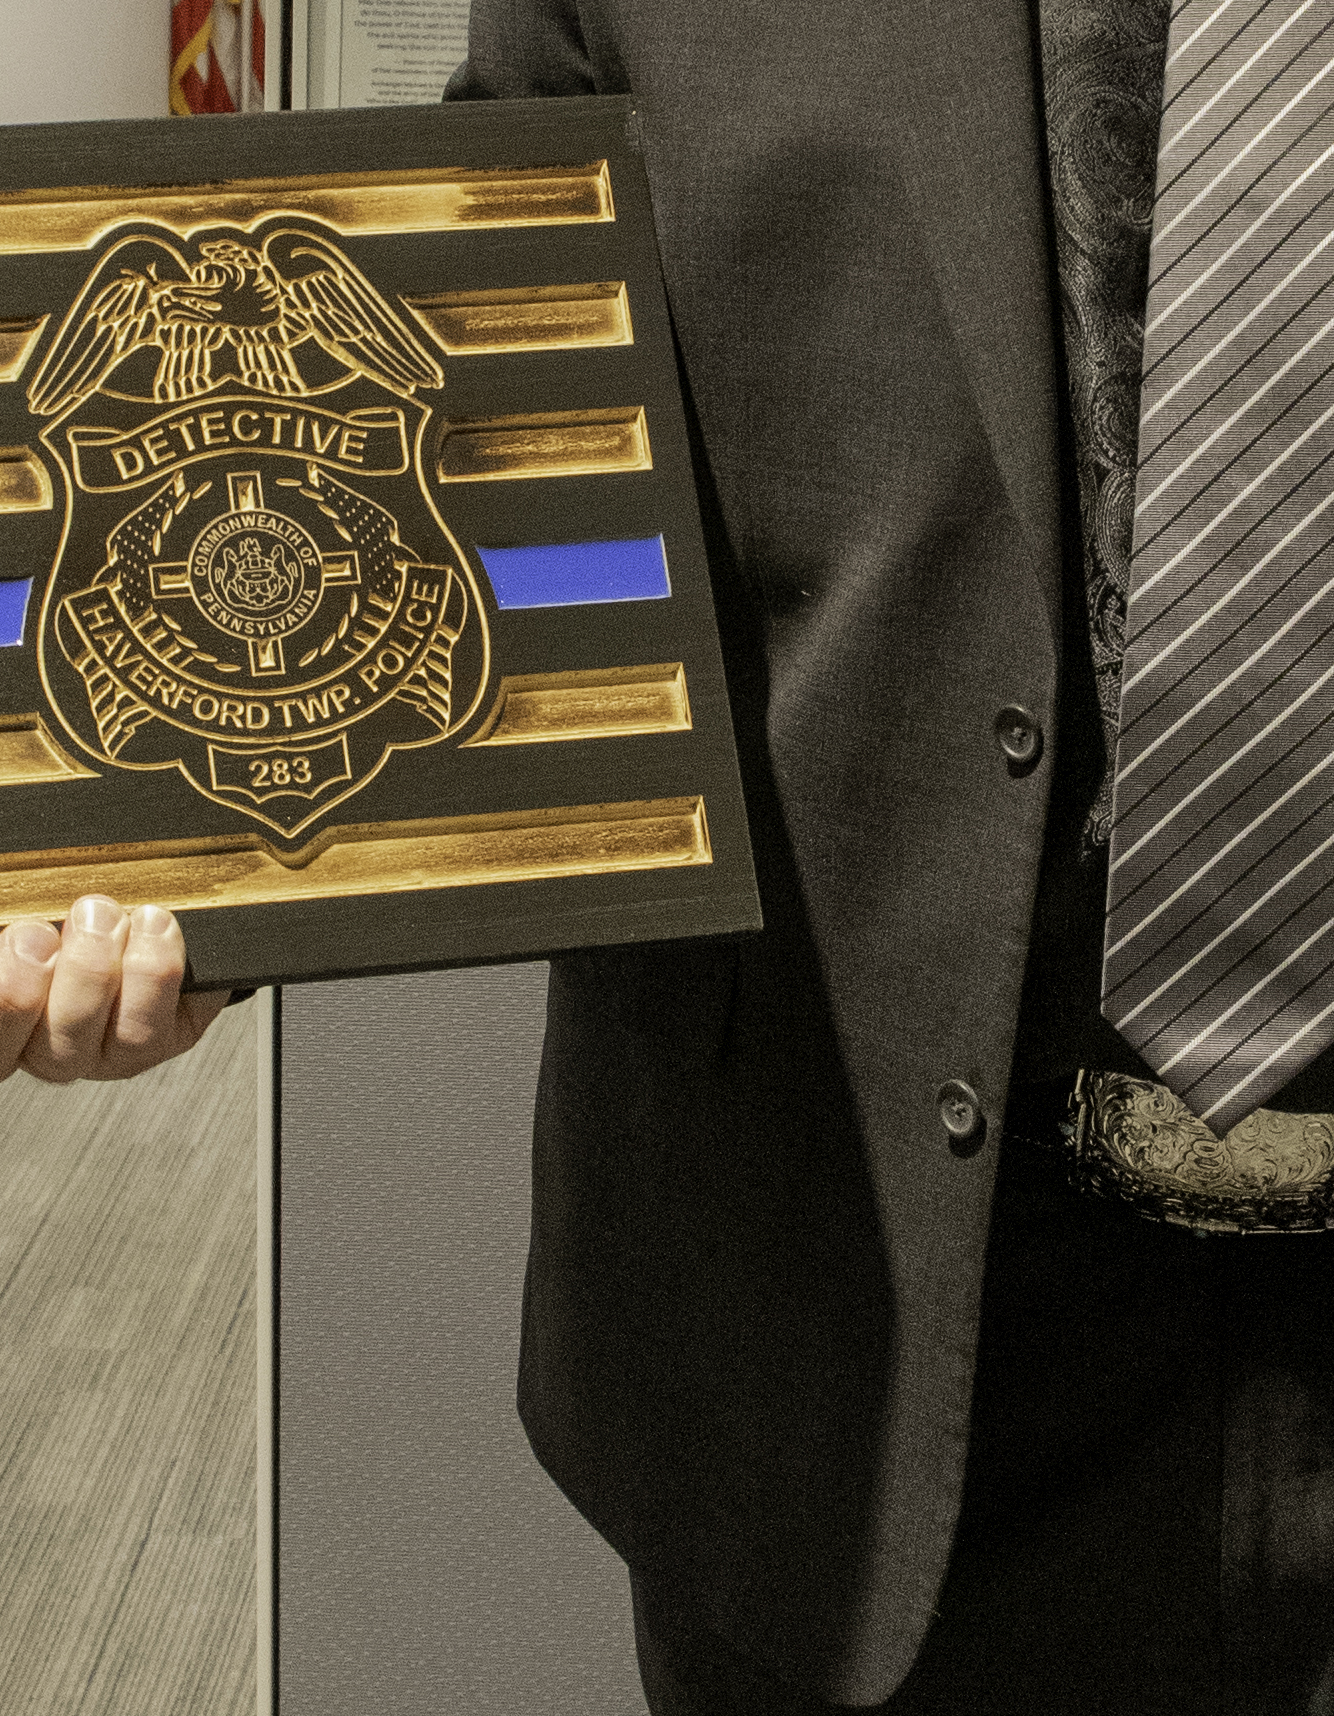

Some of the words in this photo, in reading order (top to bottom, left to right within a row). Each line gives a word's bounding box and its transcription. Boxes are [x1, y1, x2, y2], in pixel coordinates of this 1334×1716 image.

[110, 409, 368, 481] DETECTIVE
[193, 513, 304, 577] COMMONWEALTH
[299, 546, 318, 567] OF
[200, 589, 318, 635] PENNSYLVANIA
[81, 602, 270, 730] HAVERFORD
[274, 683, 362, 728] TWP.
[357, 580, 440, 693] POLICE
[248, 756, 313, 787] 283
